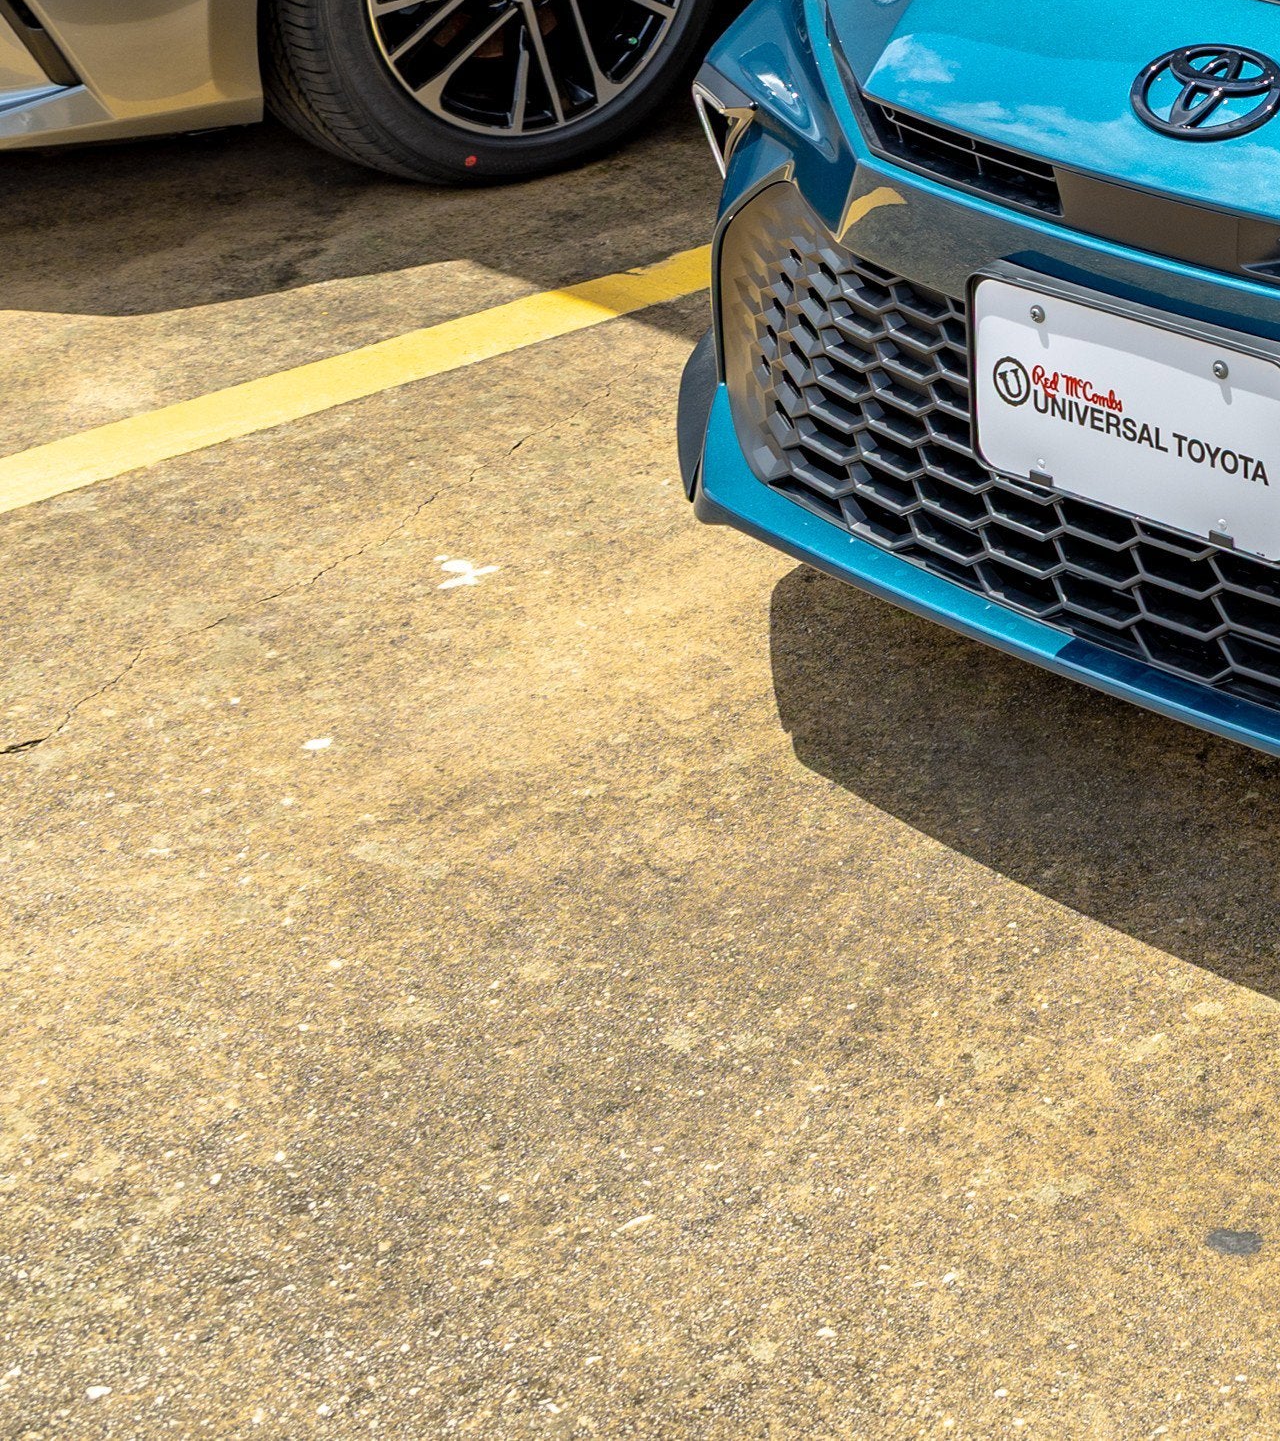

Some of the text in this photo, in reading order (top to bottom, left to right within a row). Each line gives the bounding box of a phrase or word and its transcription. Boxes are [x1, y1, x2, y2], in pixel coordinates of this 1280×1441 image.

[1032, 365, 1123, 413] Red McCombs
[1033, 389, 1270, 486] UNIVERSAL TOYOTA
